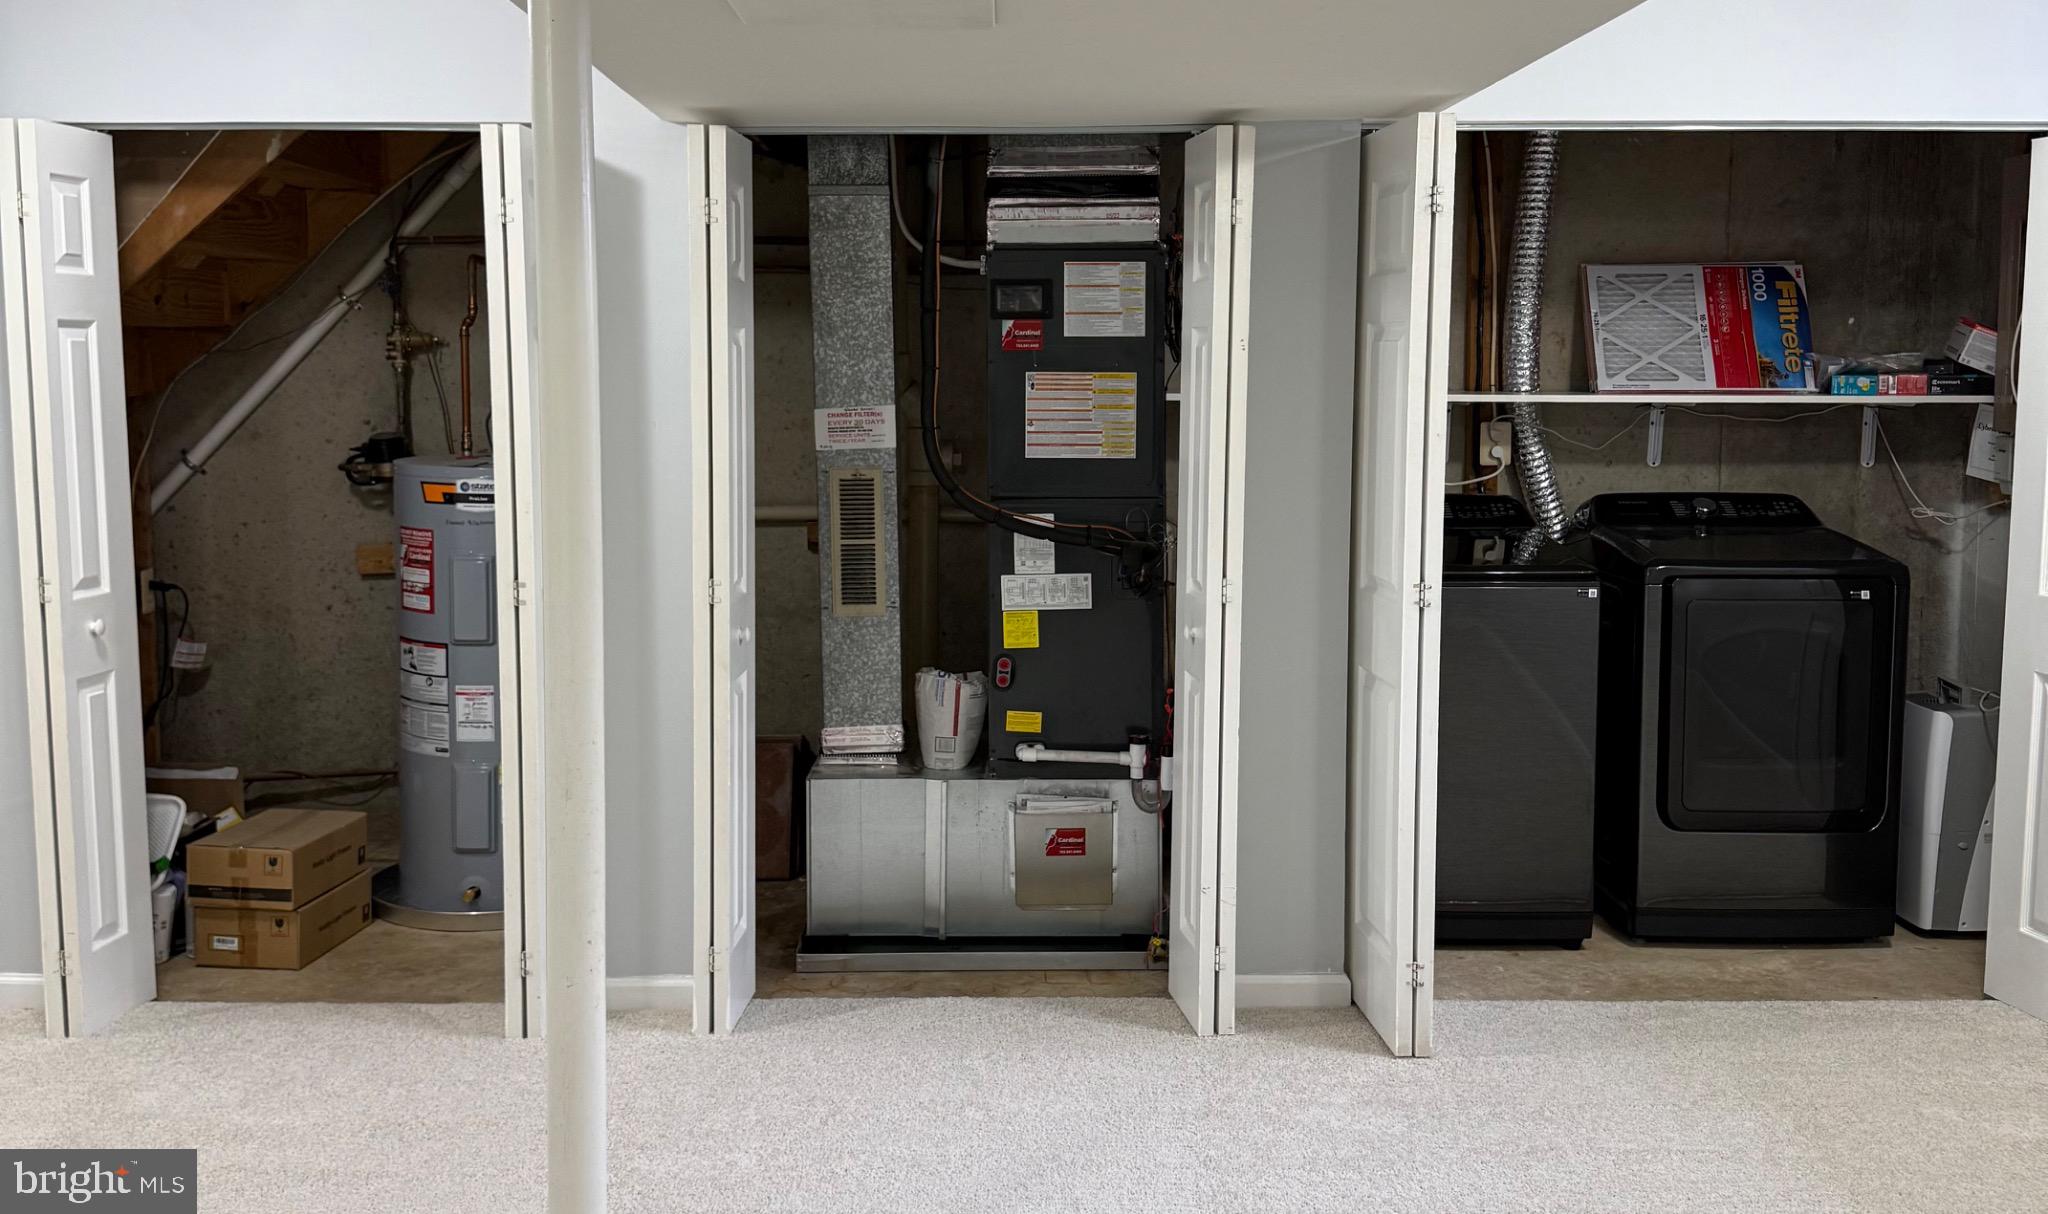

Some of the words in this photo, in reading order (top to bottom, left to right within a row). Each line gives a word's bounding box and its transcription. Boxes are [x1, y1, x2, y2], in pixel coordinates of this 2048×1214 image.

[1751, 267, 1767, 302] 1000
[1794, 268, 1802, 278] 3M
[1775, 280, 1804, 373] Filtrete
